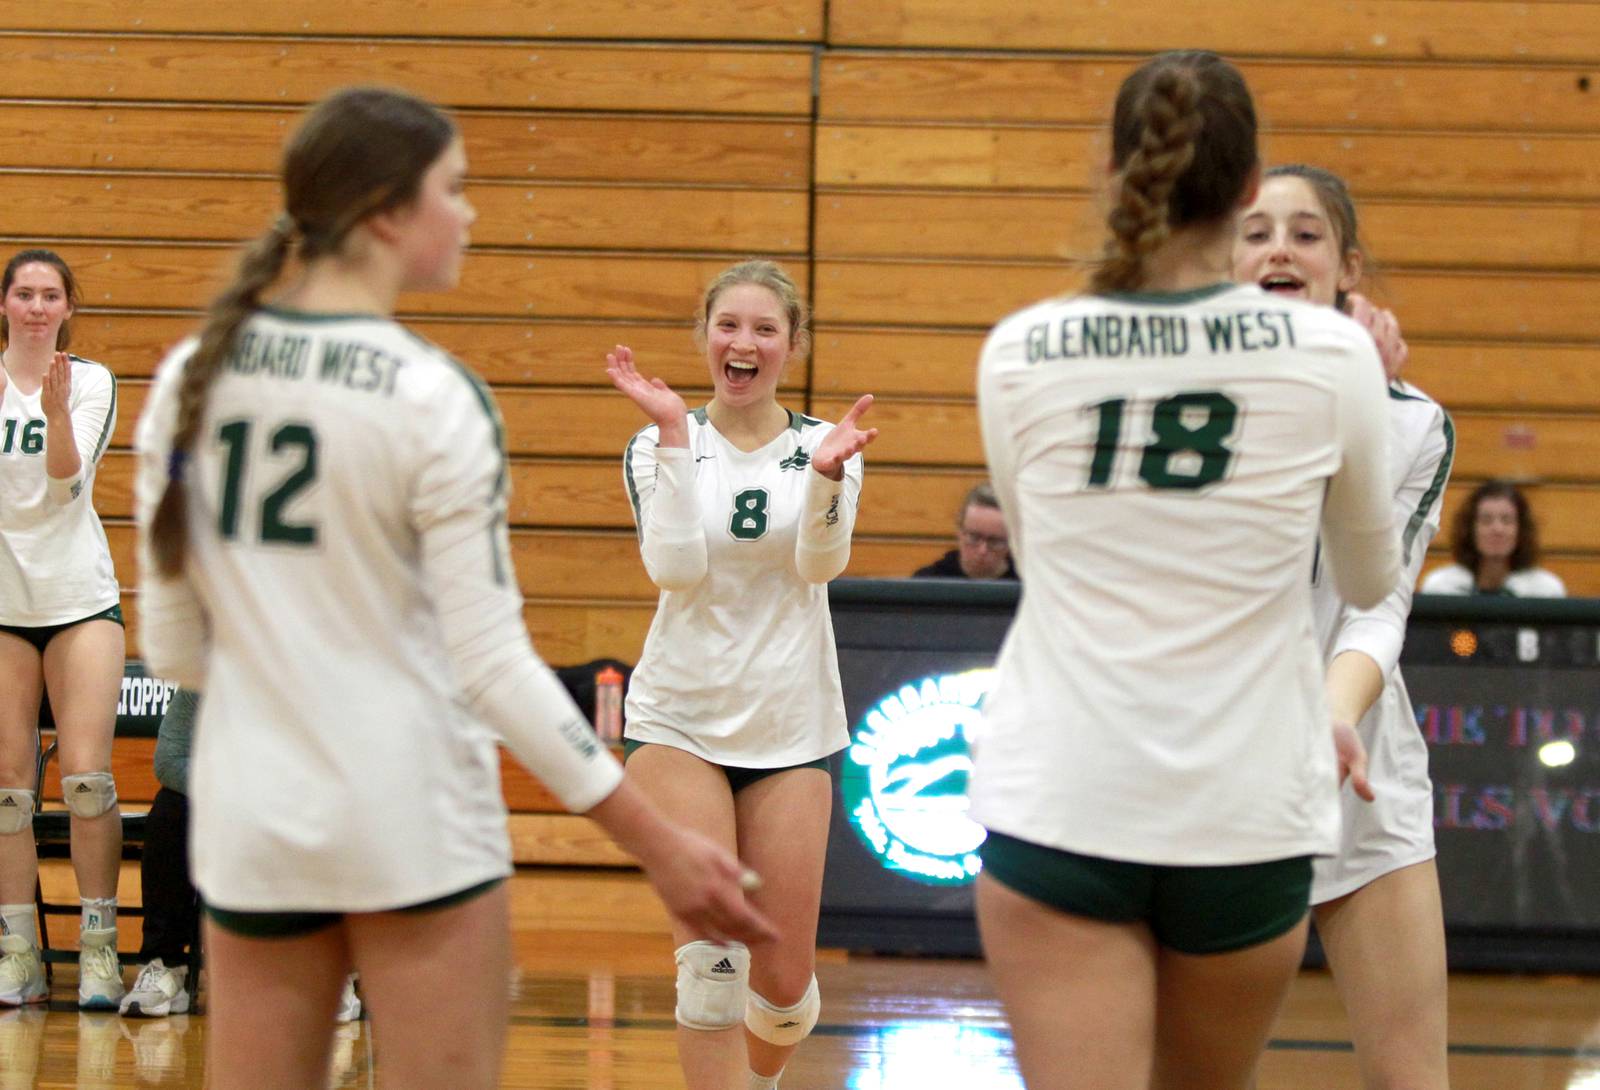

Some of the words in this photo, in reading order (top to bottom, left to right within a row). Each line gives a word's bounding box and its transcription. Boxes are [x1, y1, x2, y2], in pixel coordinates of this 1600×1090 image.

[1026, 315, 1190, 364] GLENBARD
[1204, 311, 1300, 353] WEST
[318, 339, 406, 399] WEST
[2, 418, 46, 455] 16
[1082, 391, 1239, 489] 18
[219, 419, 319, 548] 12
[729, 488, 770, 540] 8
[117, 677, 181, 716] TOPPE
